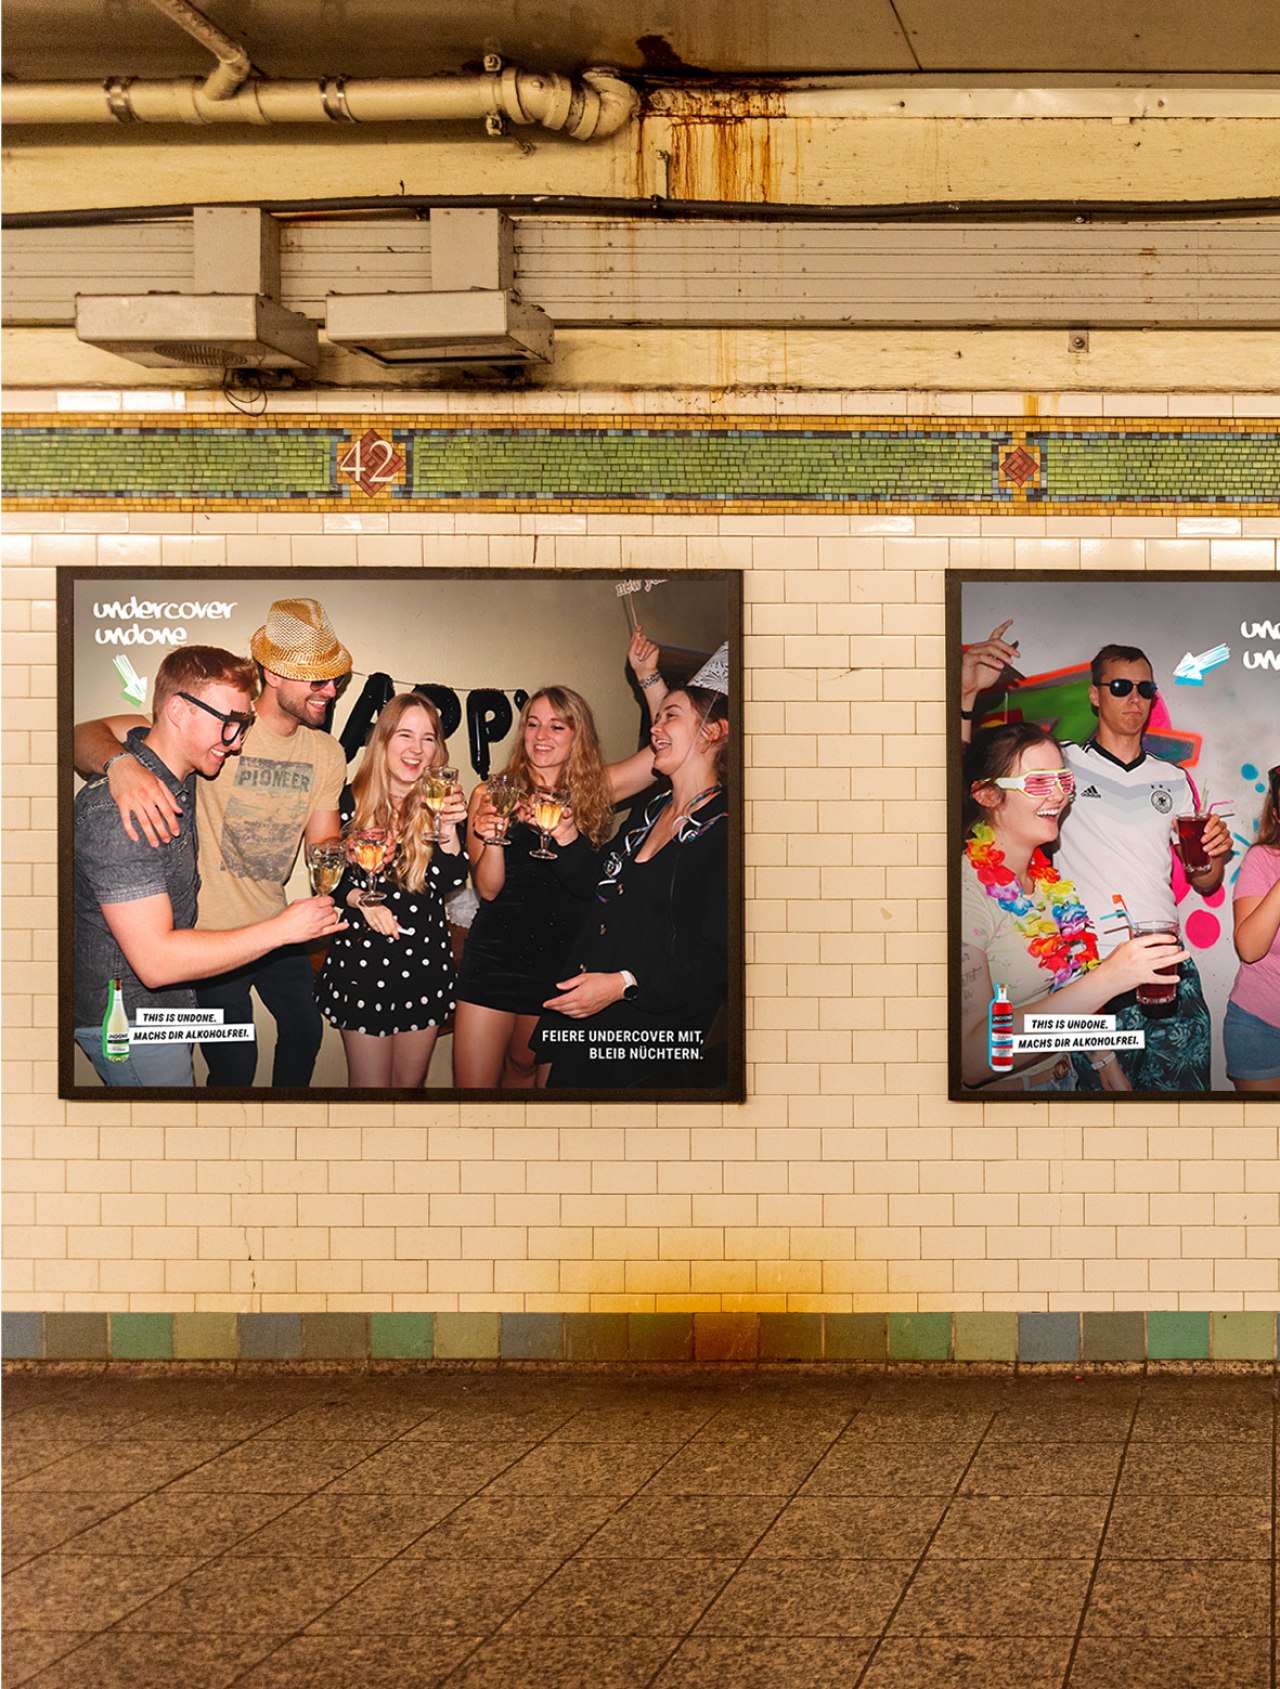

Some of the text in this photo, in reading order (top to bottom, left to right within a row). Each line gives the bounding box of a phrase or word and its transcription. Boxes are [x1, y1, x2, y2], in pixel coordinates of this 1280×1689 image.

[340, 440, 394, 482] 42
[93, 596, 238, 620] undercover
[95, 624, 188, 646] undone
[238, 769, 311, 792] PIONEER
[143, 1013, 217, 1023] THIS IS UNDONE.
[1031, 1019, 1109, 1030] THIS IS UNDONE.
[133, 1029, 250, 1041] MACHS DIR ALKOHOLFREI.
[542, 1030, 704, 1045] FEIERE UNDERCOVER MIT,
[1018, 1036, 1139, 1049] MACHS DIR ALKOHOLFREI.
[589, 1045, 703, 1060] BLEIB NÜCHTERN.
